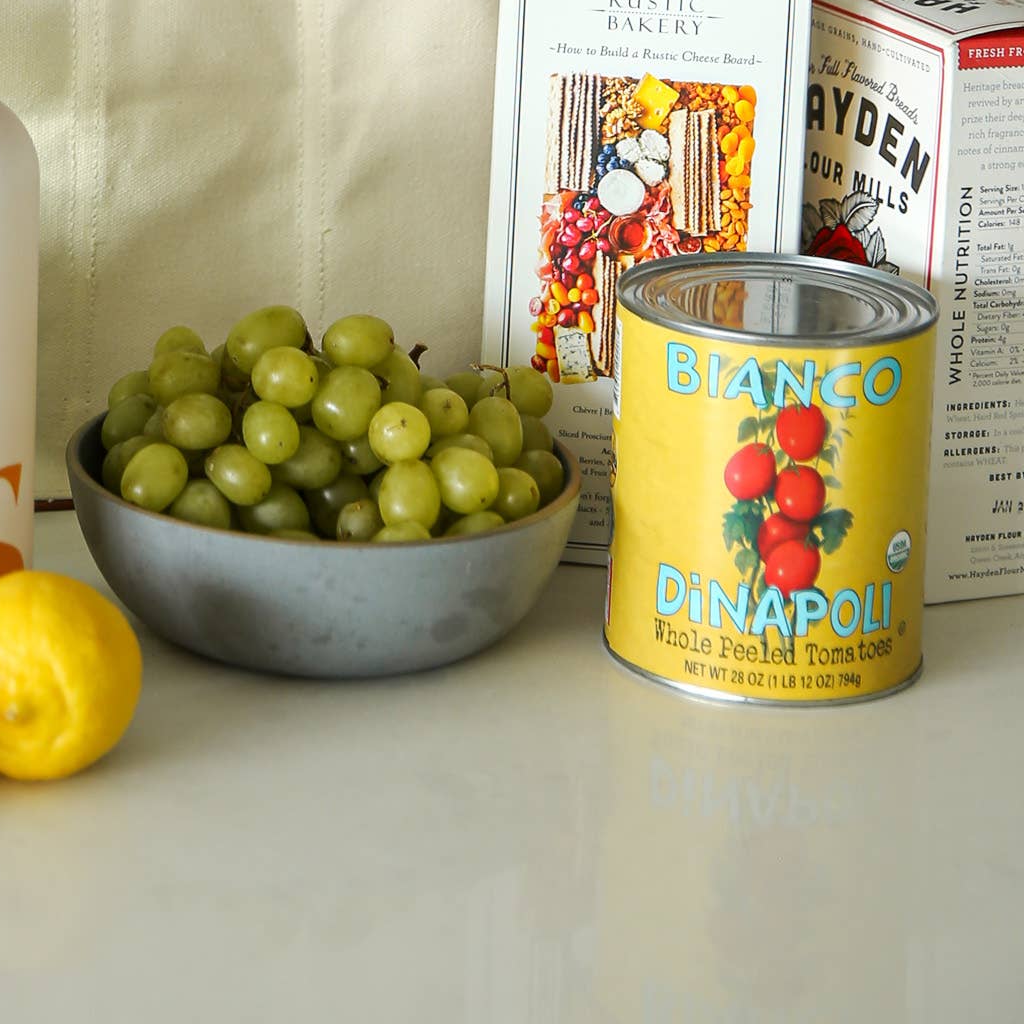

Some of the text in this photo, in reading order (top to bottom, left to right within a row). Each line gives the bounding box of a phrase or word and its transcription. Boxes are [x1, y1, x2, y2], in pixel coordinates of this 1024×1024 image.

[607, 15, 704, 36] BAKERY
[586, 47, 597, 56] to
[600, 45, 629, 58] Build
[632, 51, 639, 59] a
[642, 48, 678, 62] Rustic
[682, 50, 720, 64] Cheese
[968, 46, 1024, 59] FRESH FR
[819, 54, 919, 125] Full Flavored Breads
[963, 81, 1001, 93] Heritage
[1001, 96, 1013, 108] by
[983, 143, 993, 154] of
[852, 170, 909, 214] MILLS
[953, 186, 974, 301] NUTRITION
[948, 310, 966, 386] WHOLE
[665, 342, 903, 409] BIANCO
[946, 399, 1012, 412] INGREDIENTS:
[944, 429, 990, 440] STORAGE:
[943, 445, 1001, 457] ALLERGENS:
[992, 499, 1013, 514] JAN
[656, 562, 892, 638] DiNAPOLI
[654, 617, 893, 666] Whole Peeled Tomatoes
[684, 659, 707, 678] NET
[709, 665, 728, 682] WT
[731, 670, 744, 685] 28
[747, 672, 765, 687] OZ
[782, 675, 796, 689] LB
[801, 675, 813, 689] 12
[816, 674, 835, 689] OZ)
[838, 673, 862, 688] 794g
